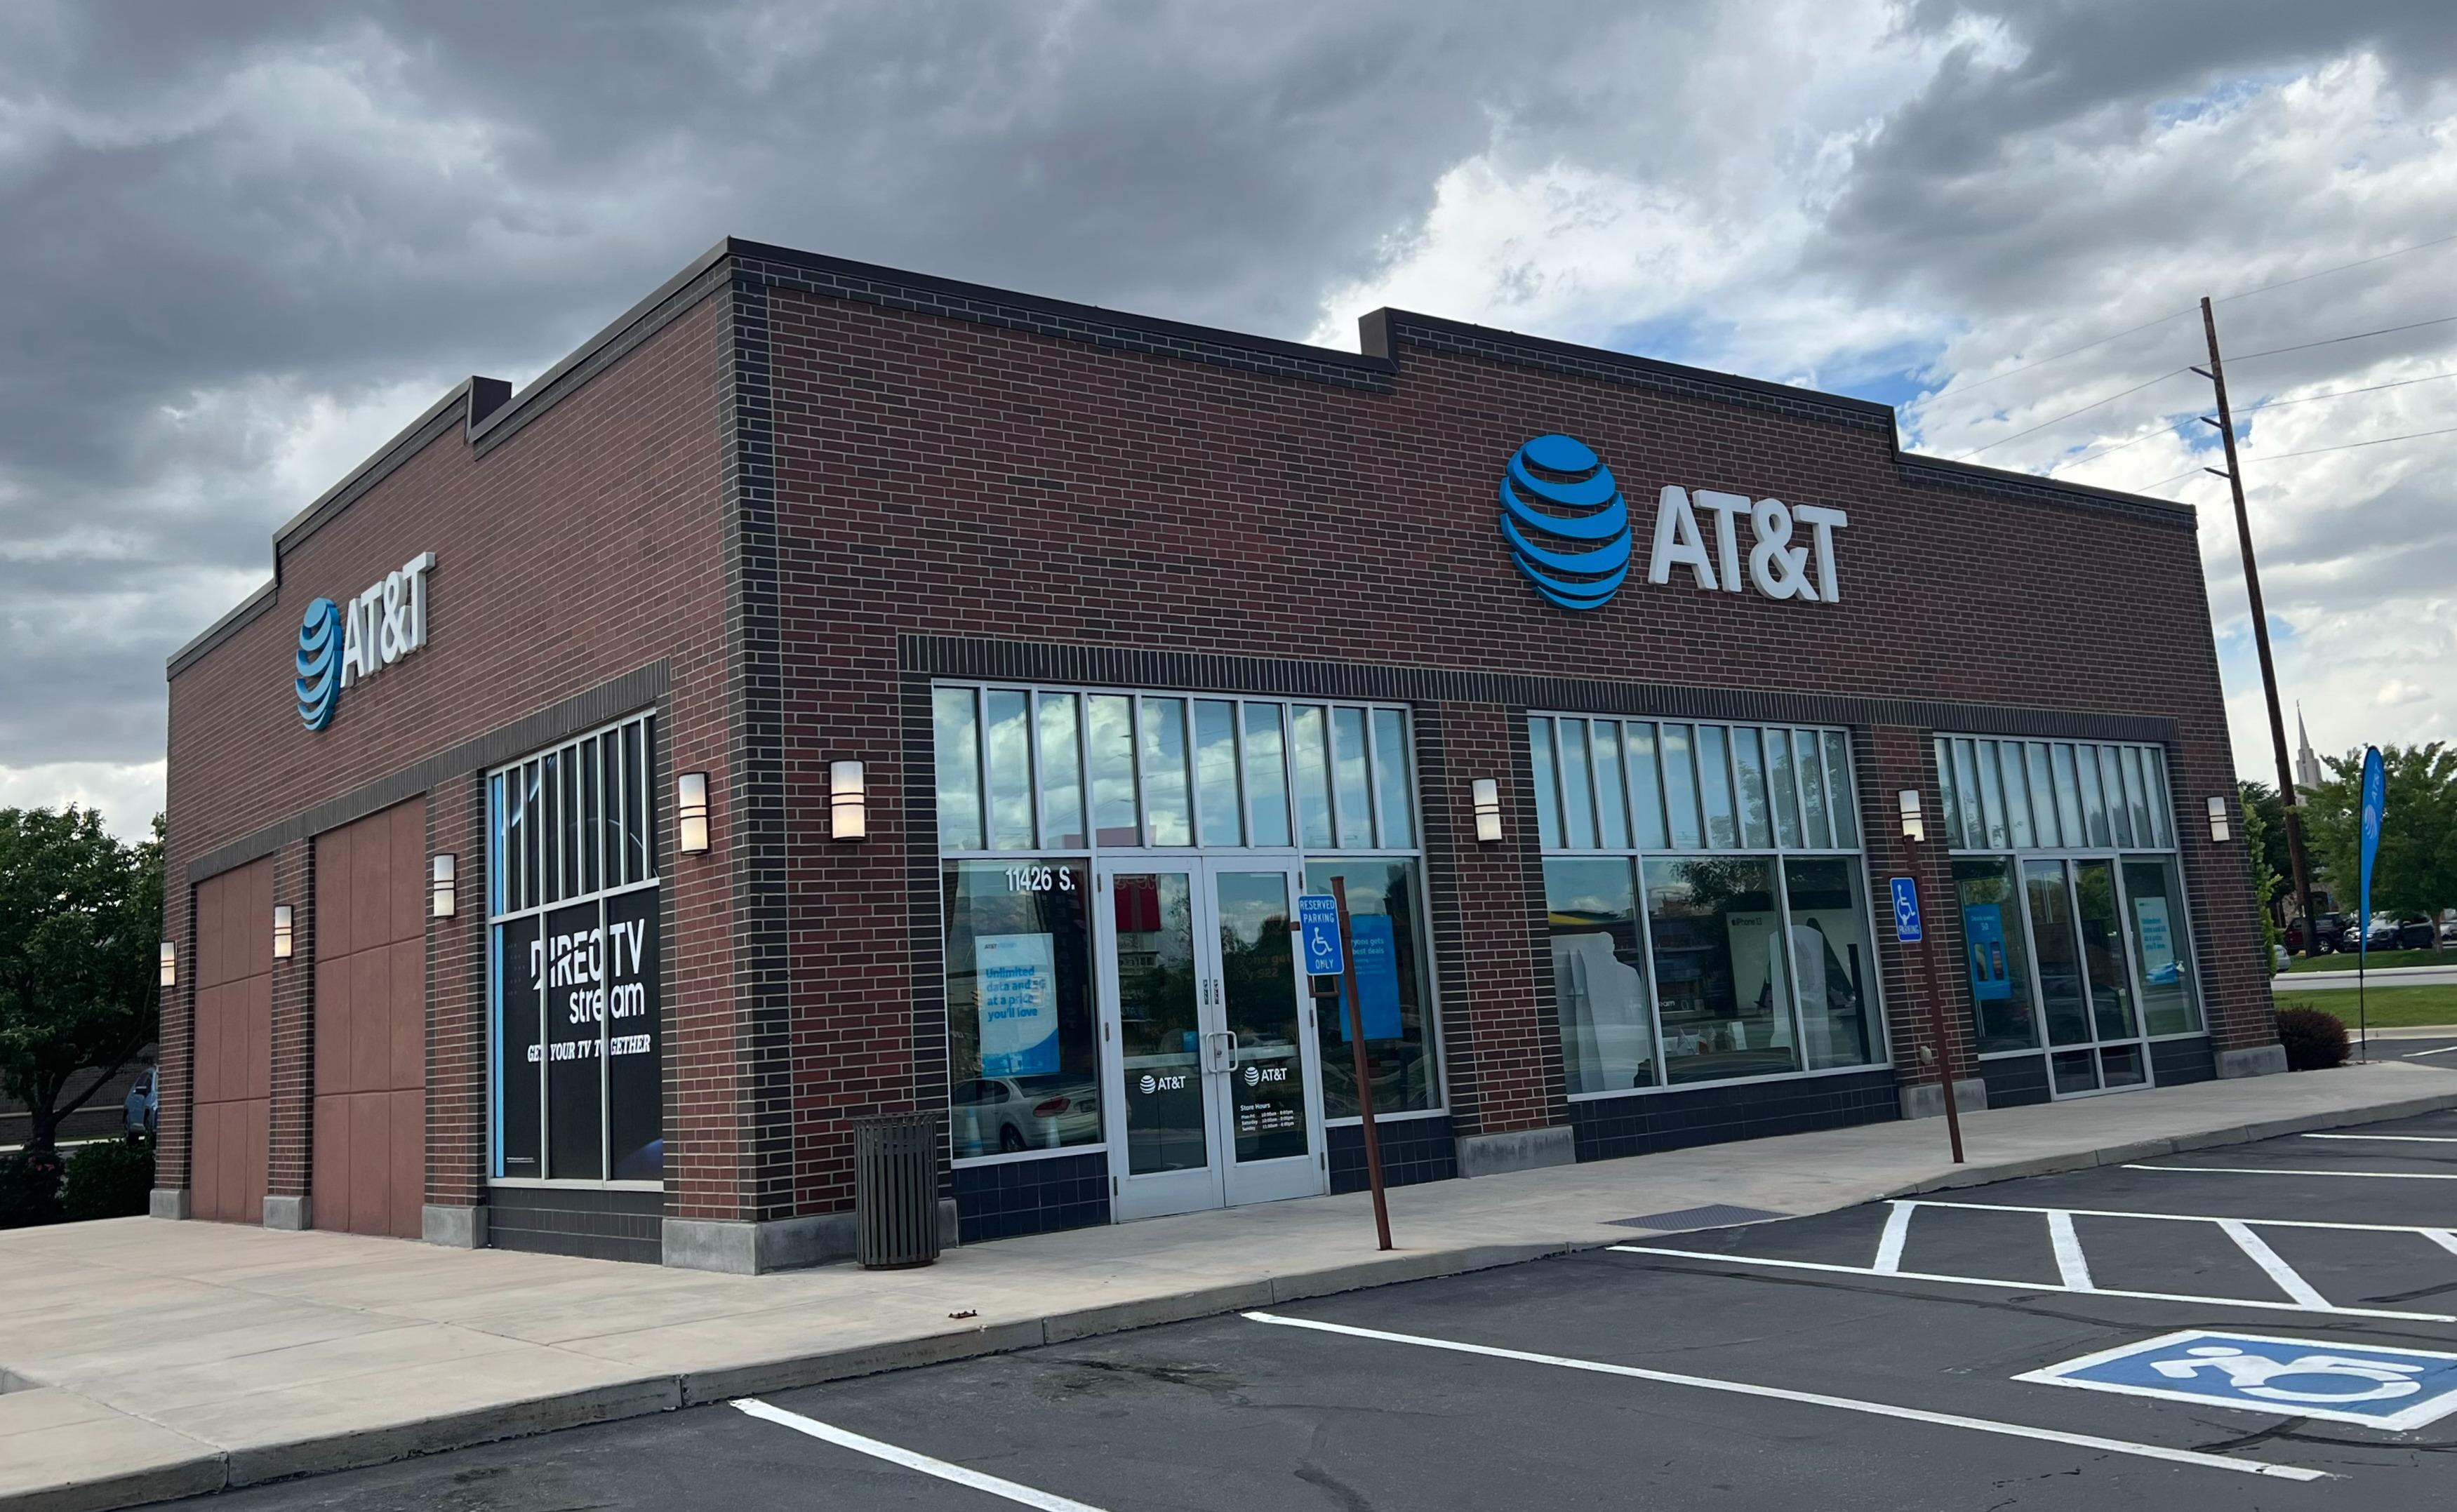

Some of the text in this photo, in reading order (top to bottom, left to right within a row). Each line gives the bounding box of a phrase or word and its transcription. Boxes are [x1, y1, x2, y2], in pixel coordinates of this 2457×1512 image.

[1647, 485, 1848, 603] AT&T
[340, 551, 435, 688] AT&T
[1005, 865, 1075, 891] 11426 S.
[1300, 899, 1335, 910] RESERVED
[1303, 913, 1335, 923] PARKING
[1315, 959, 1333, 969] ONLY
[986, 966, 1034, 978] Unlimited
[987, 982, 1009, 991] data
[1012, 979, 1031, 990] and
[569, 982, 644, 1024] stream
[987, 995, 999, 1005] at
[1008, 993, 1034, 1006] price
[1017, 1008, 1038, 1017] love
[527, 1033, 651, 1062] GE YOUR TV TGETHER
[1261, 1068, 1287, 1082] AT&T
[1157, 1076, 1185, 1090] AT&T
